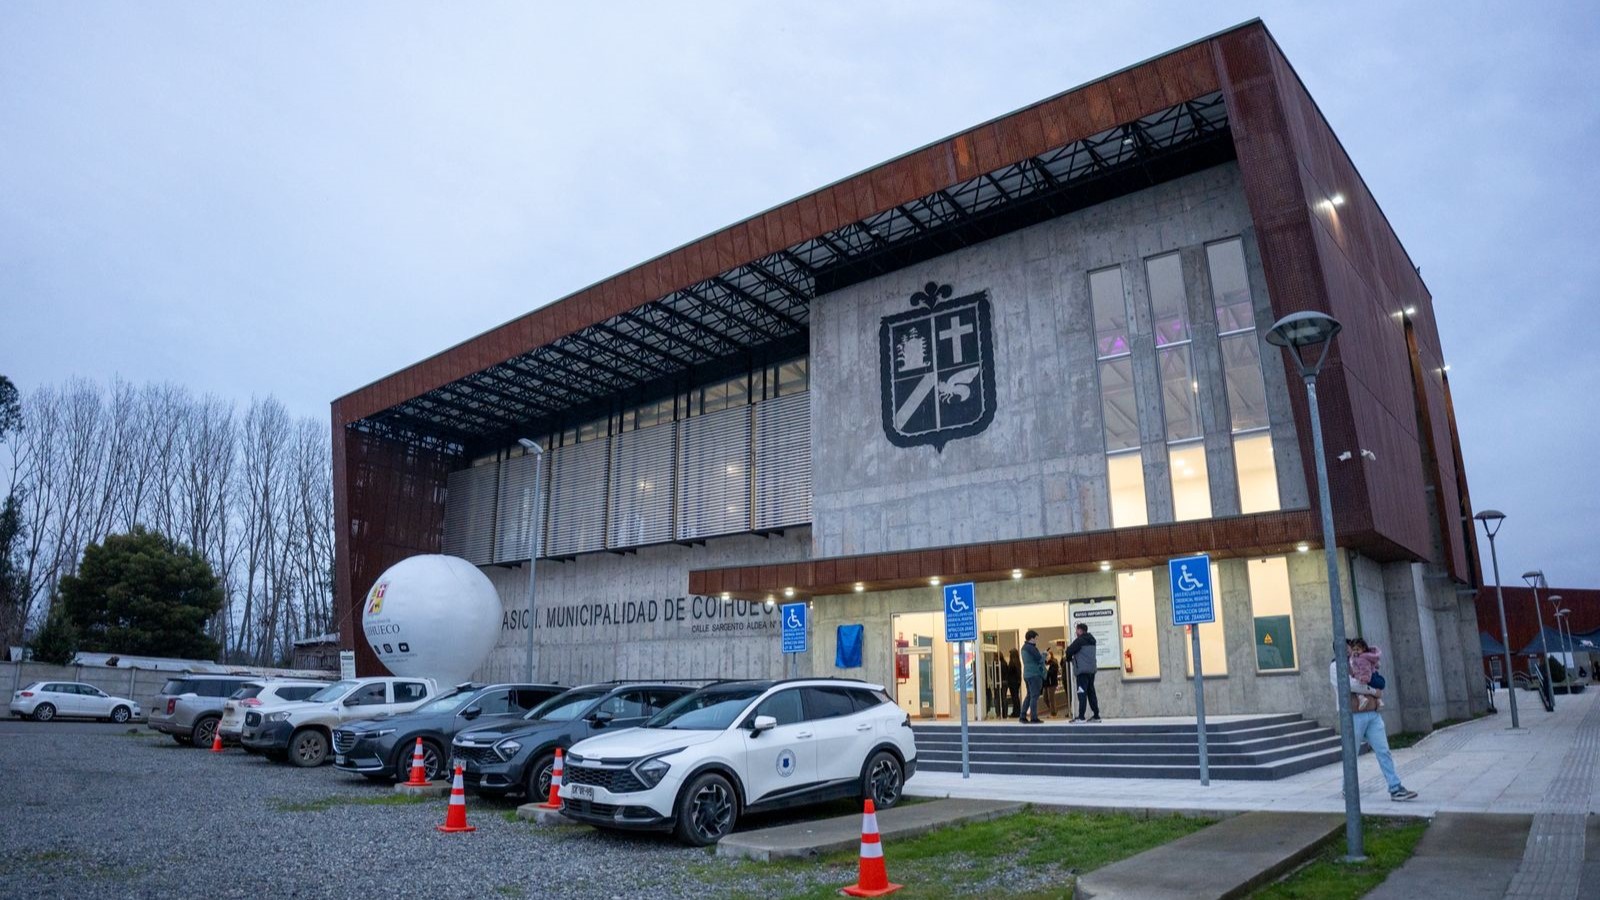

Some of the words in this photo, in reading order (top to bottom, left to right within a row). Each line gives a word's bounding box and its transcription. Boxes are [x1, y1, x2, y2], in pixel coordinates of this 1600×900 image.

[546, 600, 658, 628] MUNICIPALIDAD
[664, 598, 685, 621] DE
[692, 624, 710, 632] CALLE
[712, 622, 744, 632] SARGENTO
[746, 621, 767, 630] ALDEA
